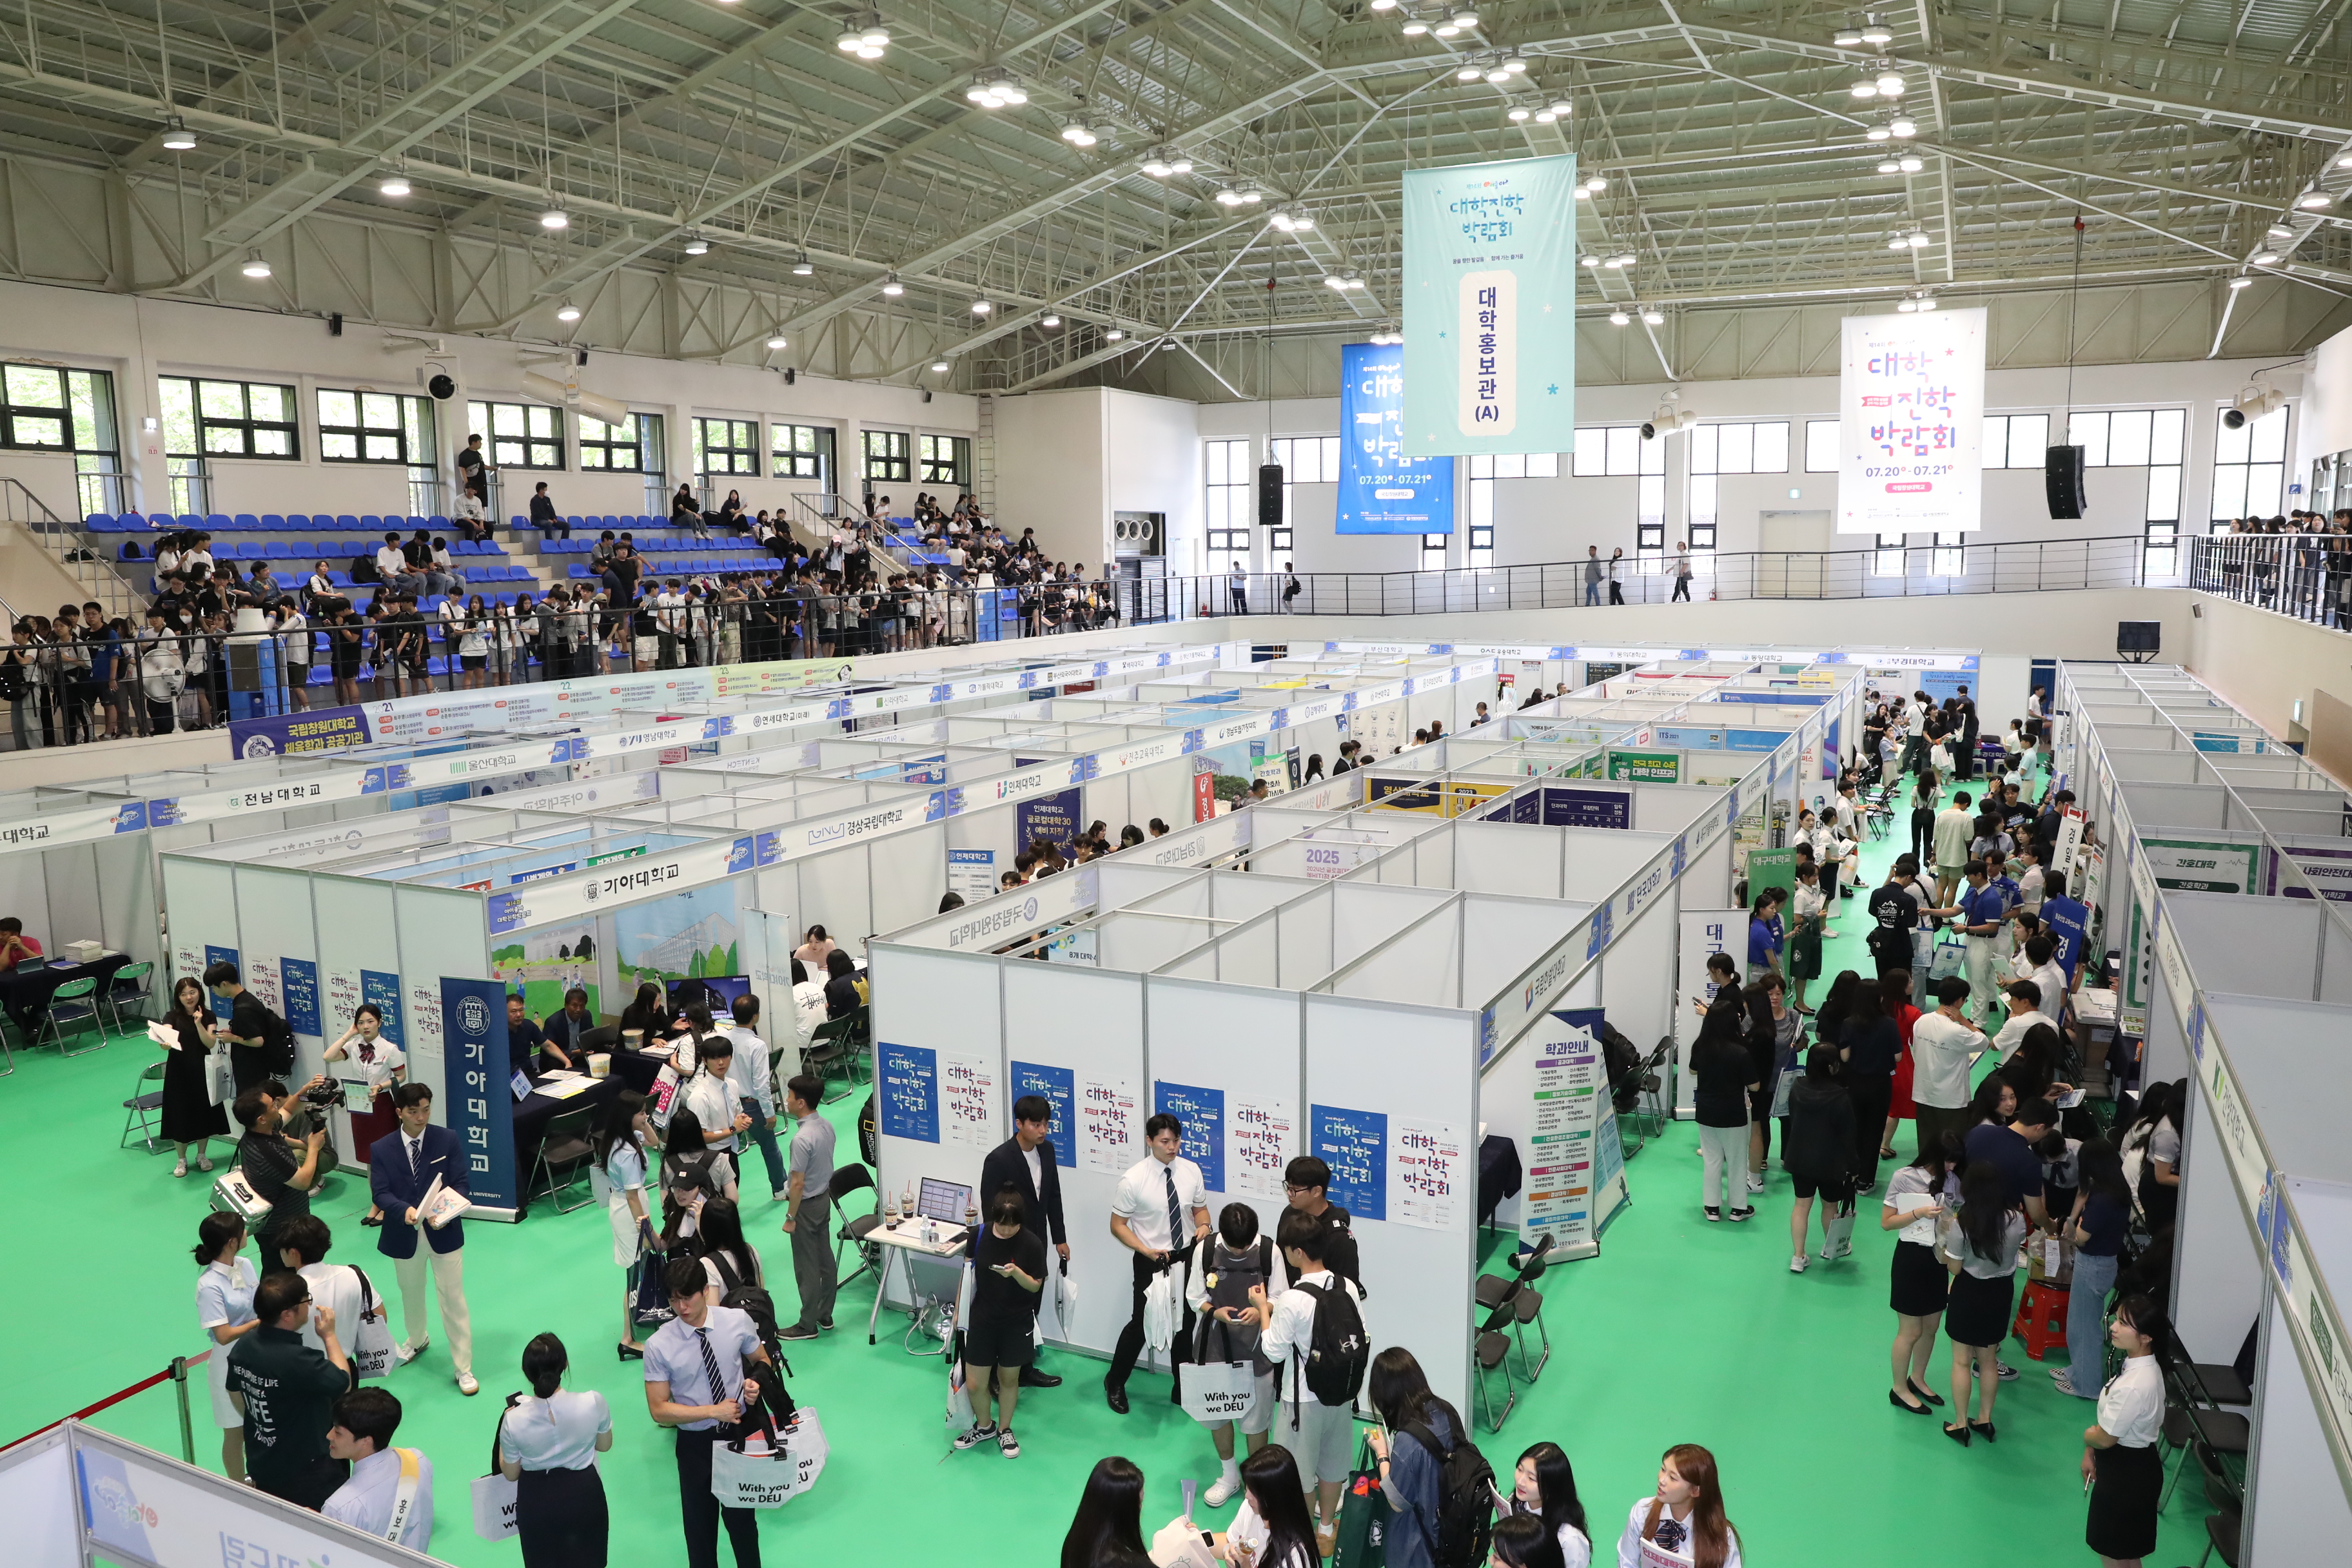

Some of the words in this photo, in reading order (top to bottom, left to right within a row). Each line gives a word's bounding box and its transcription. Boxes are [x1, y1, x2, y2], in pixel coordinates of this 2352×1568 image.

[1450, 193, 1524, 218] 대학진학
[1462, 220, 1512, 243] 박람회
[1478, 286, 1496, 400] 대학홍보관
[1868, 351, 1934, 383] 대학
[1897, 385, 1956, 420] 진학
[1475, 405, 1499, 422] (A)
[1871, 420, 1955, 456] 박람회
[1891, 658, 1935, 666] 부경대학교
[1053, 669, 1083, 680] 부산외국어대학교
[553, 681, 572, 691] 2022
[977, 681, 1004, 692] 가톨릭대학교
[372, 702, 395, 714] 2021
[884, 695, 909, 706] 신라대학교
[288, 716, 357, 737] 국립창원대학교
[762, 710, 810, 726] 연세대학교(미래)
[284, 737, 324, 754] 체육학과
[326, 731, 364, 748] 공공기관
[643, 729, 677, 743] 영남대학교
[468, 754, 516, 771] 울산대학교
[1128, 745, 1164, 763] 진주교육대학교
[1259, 768, 1281, 777] 간호학과
[1632, 767, 1649, 777] 대학
[1651, 768, 1676, 778] 인프라
[1008, 775, 1041, 794] 인제대학교
[244, 783, 321, 807] 전남대학교
[1034, 805, 1064, 814] 인제대학교
[847, 809, 903, 836] 경상국립대학교
[1026, 814, 1062, 826] 글로컬대학
[1062, 817, 1072, 826] 30
[0, 825, 51, 844] 대학교
[1035, 826, 1048, 835] 예비
[1050, 827, 1064, 836] 지정
[956, 852, 988, 861] 인제대학교
[1306, 848, 1340, 865] 2025
[1753, 854, 1791, 866] 대구대학교
[2175, 858, 2217, 870] 간호대학
[603, 864, 680, 895] 가야대학교
[1636, 867, 1661, 905] 단국대학교
[2178, 881, 2210, 890] 간호학과
[497, 910, 531, 923] 대학진학박람회
[504, 905, 524, 914] 아이좋아
[1068, 951, 1079, 959] 8개
[1534, 954, 1567, 999] 국립한밭대학교
[413, 988, 433, 1004] 대학
[422, 1004, 440, 1021] 진학
[417, 1017, 442, 1034] 박람회
[1545, 1039, 1589, 1056] 학과안내
[888, 1056, 916, 1077] 대학
[947, 1066, 975, 1086] 대학
[901, 1075, 926, 1096] 진학
[891, 1091, 927, 1112] 박람회
[960, 1084, 986, 1105] 진학
[464, 1043, 489, 1173] 가야대학교
[950, 1101, 986, 1122] 박람회
[1237, 1108, 1270, 1131] 대학
[2222, 1083, 2246, 1159] 건양대학교
[1252, 1130, 1282, 1153] 진학
[1324, 1121, 1360, 1145] 대학
[1402, 1133, 1438, 1157] 대학
[1240, 1146, 1283, 1170] 박람회
[1340, 1143, 1372, 1167] 진학
[1326, 1160, 1372, 1185] 박람회
[1418, 1155, 1450, 1179] 진학
[1404, 1172, 1449, 1197] 박람회
[356, 1350, 371, 1360] With
[371, 1348, 388, 1358] you
[359, 1363, 369, 1372] we
[369, 1359, 385, 1370] DEU
[264, 1377, 279, 1387] LIFE
[1204, 1390, 1229, 1402] With
[1231, 1390, 1251, 1404] you
[244, 1391, 273, 1424] LIFE
[1223, 1402, 1244, 1413] DEU
[798, 1458, 814, 1469] ou
[738, 1482, 765, 1493] With
[769, 1482, 790, 1496] you
[758, 1493, 781, 1504] DEU
